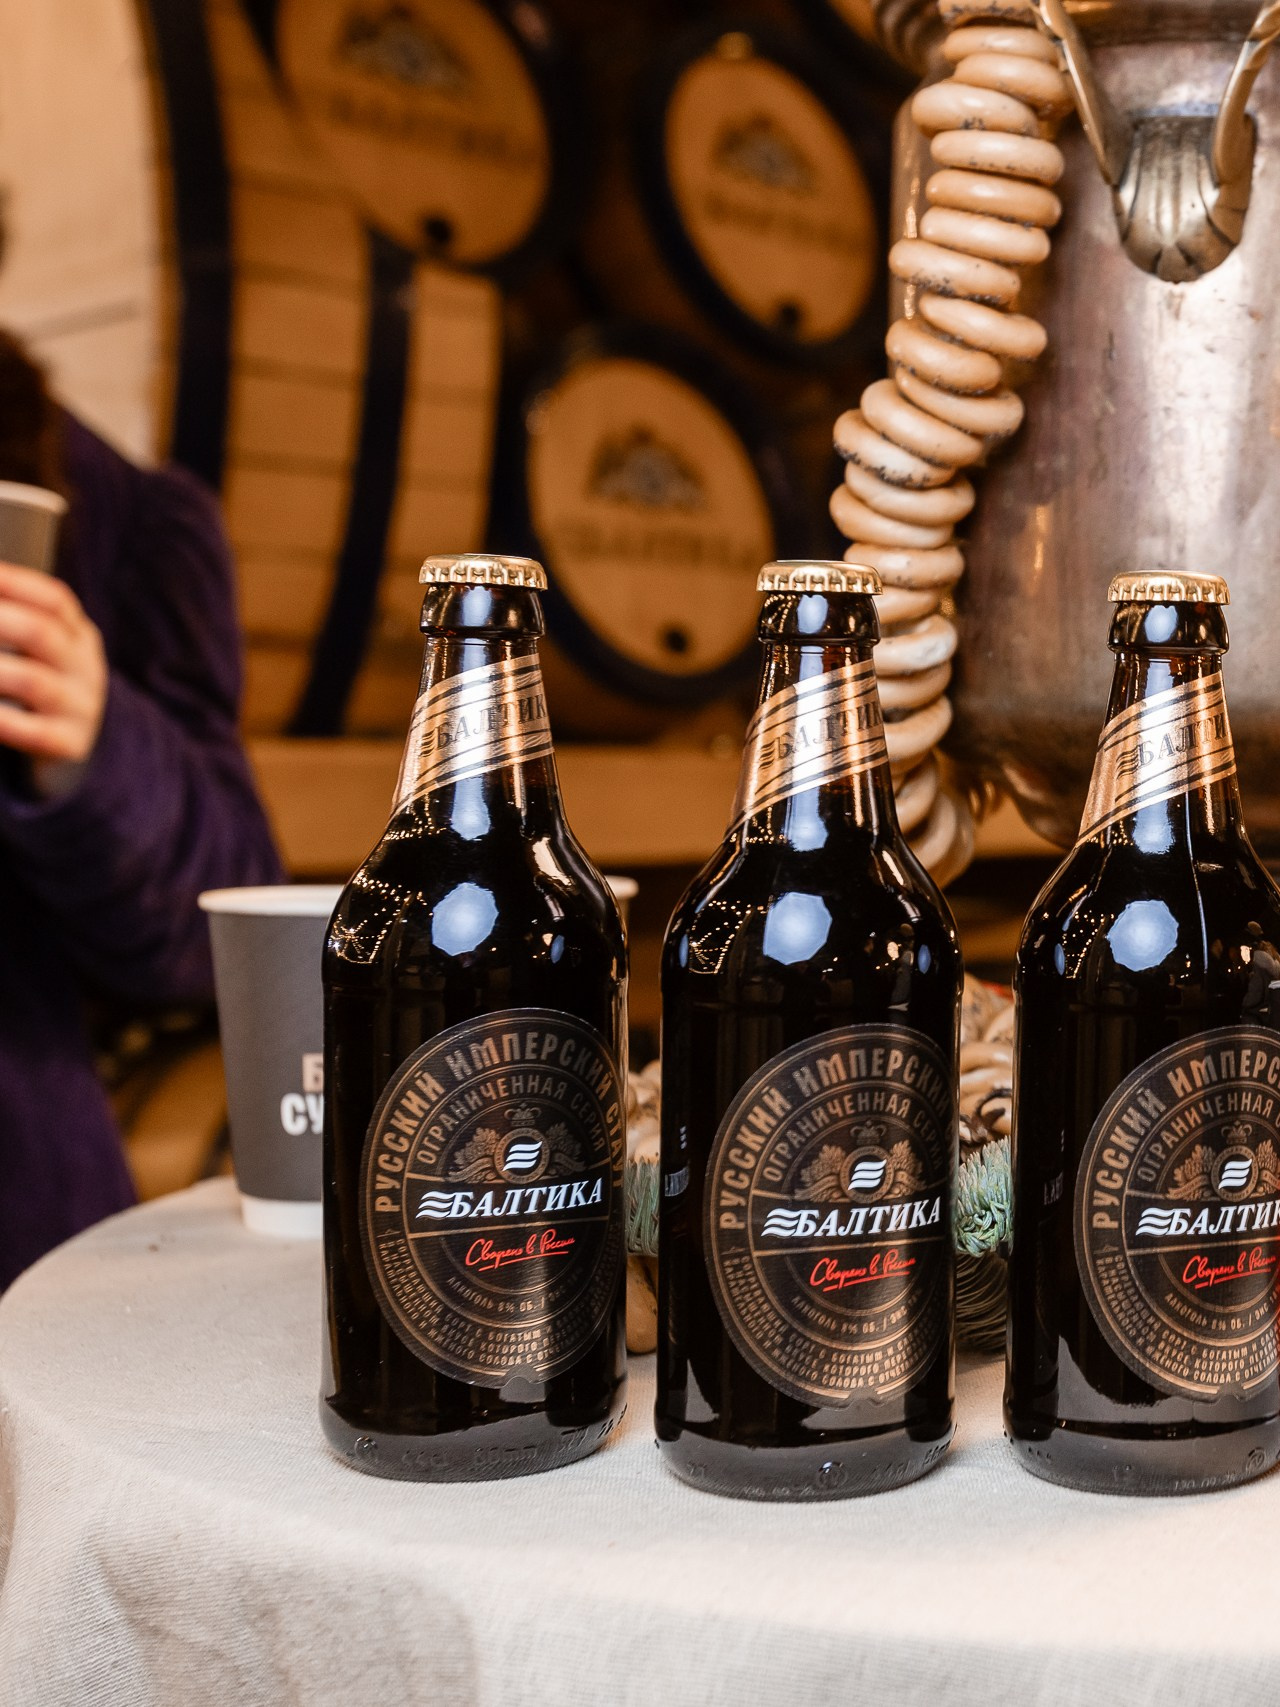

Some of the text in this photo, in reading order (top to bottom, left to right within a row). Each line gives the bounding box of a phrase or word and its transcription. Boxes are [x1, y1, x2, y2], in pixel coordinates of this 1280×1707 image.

[374, 1070, 446, 1213] РУССКИЙ
[444, 1032, 614, 1100] ИМПЕРСКИЙ
[416, 1074, 568, 1165] ОГРАНИЧЕННАЯ
[570, 1092, 606, 1152] СЕРИЯ
[719, 1086, 792, 1230] РУССКИЙ
[762, 1091, 912, 1183] ОГРАНИЧЕННАЯ
[1092, 1086, 1168, 1230] РУССКИЙ
[1137, 1091, 1273, 1182] ОГРАНИЧЕННАЯ
[448, 1177, 603, 1218] БАЛТИКА
[790, 1196, 941, 1237] БАЛТИКА
